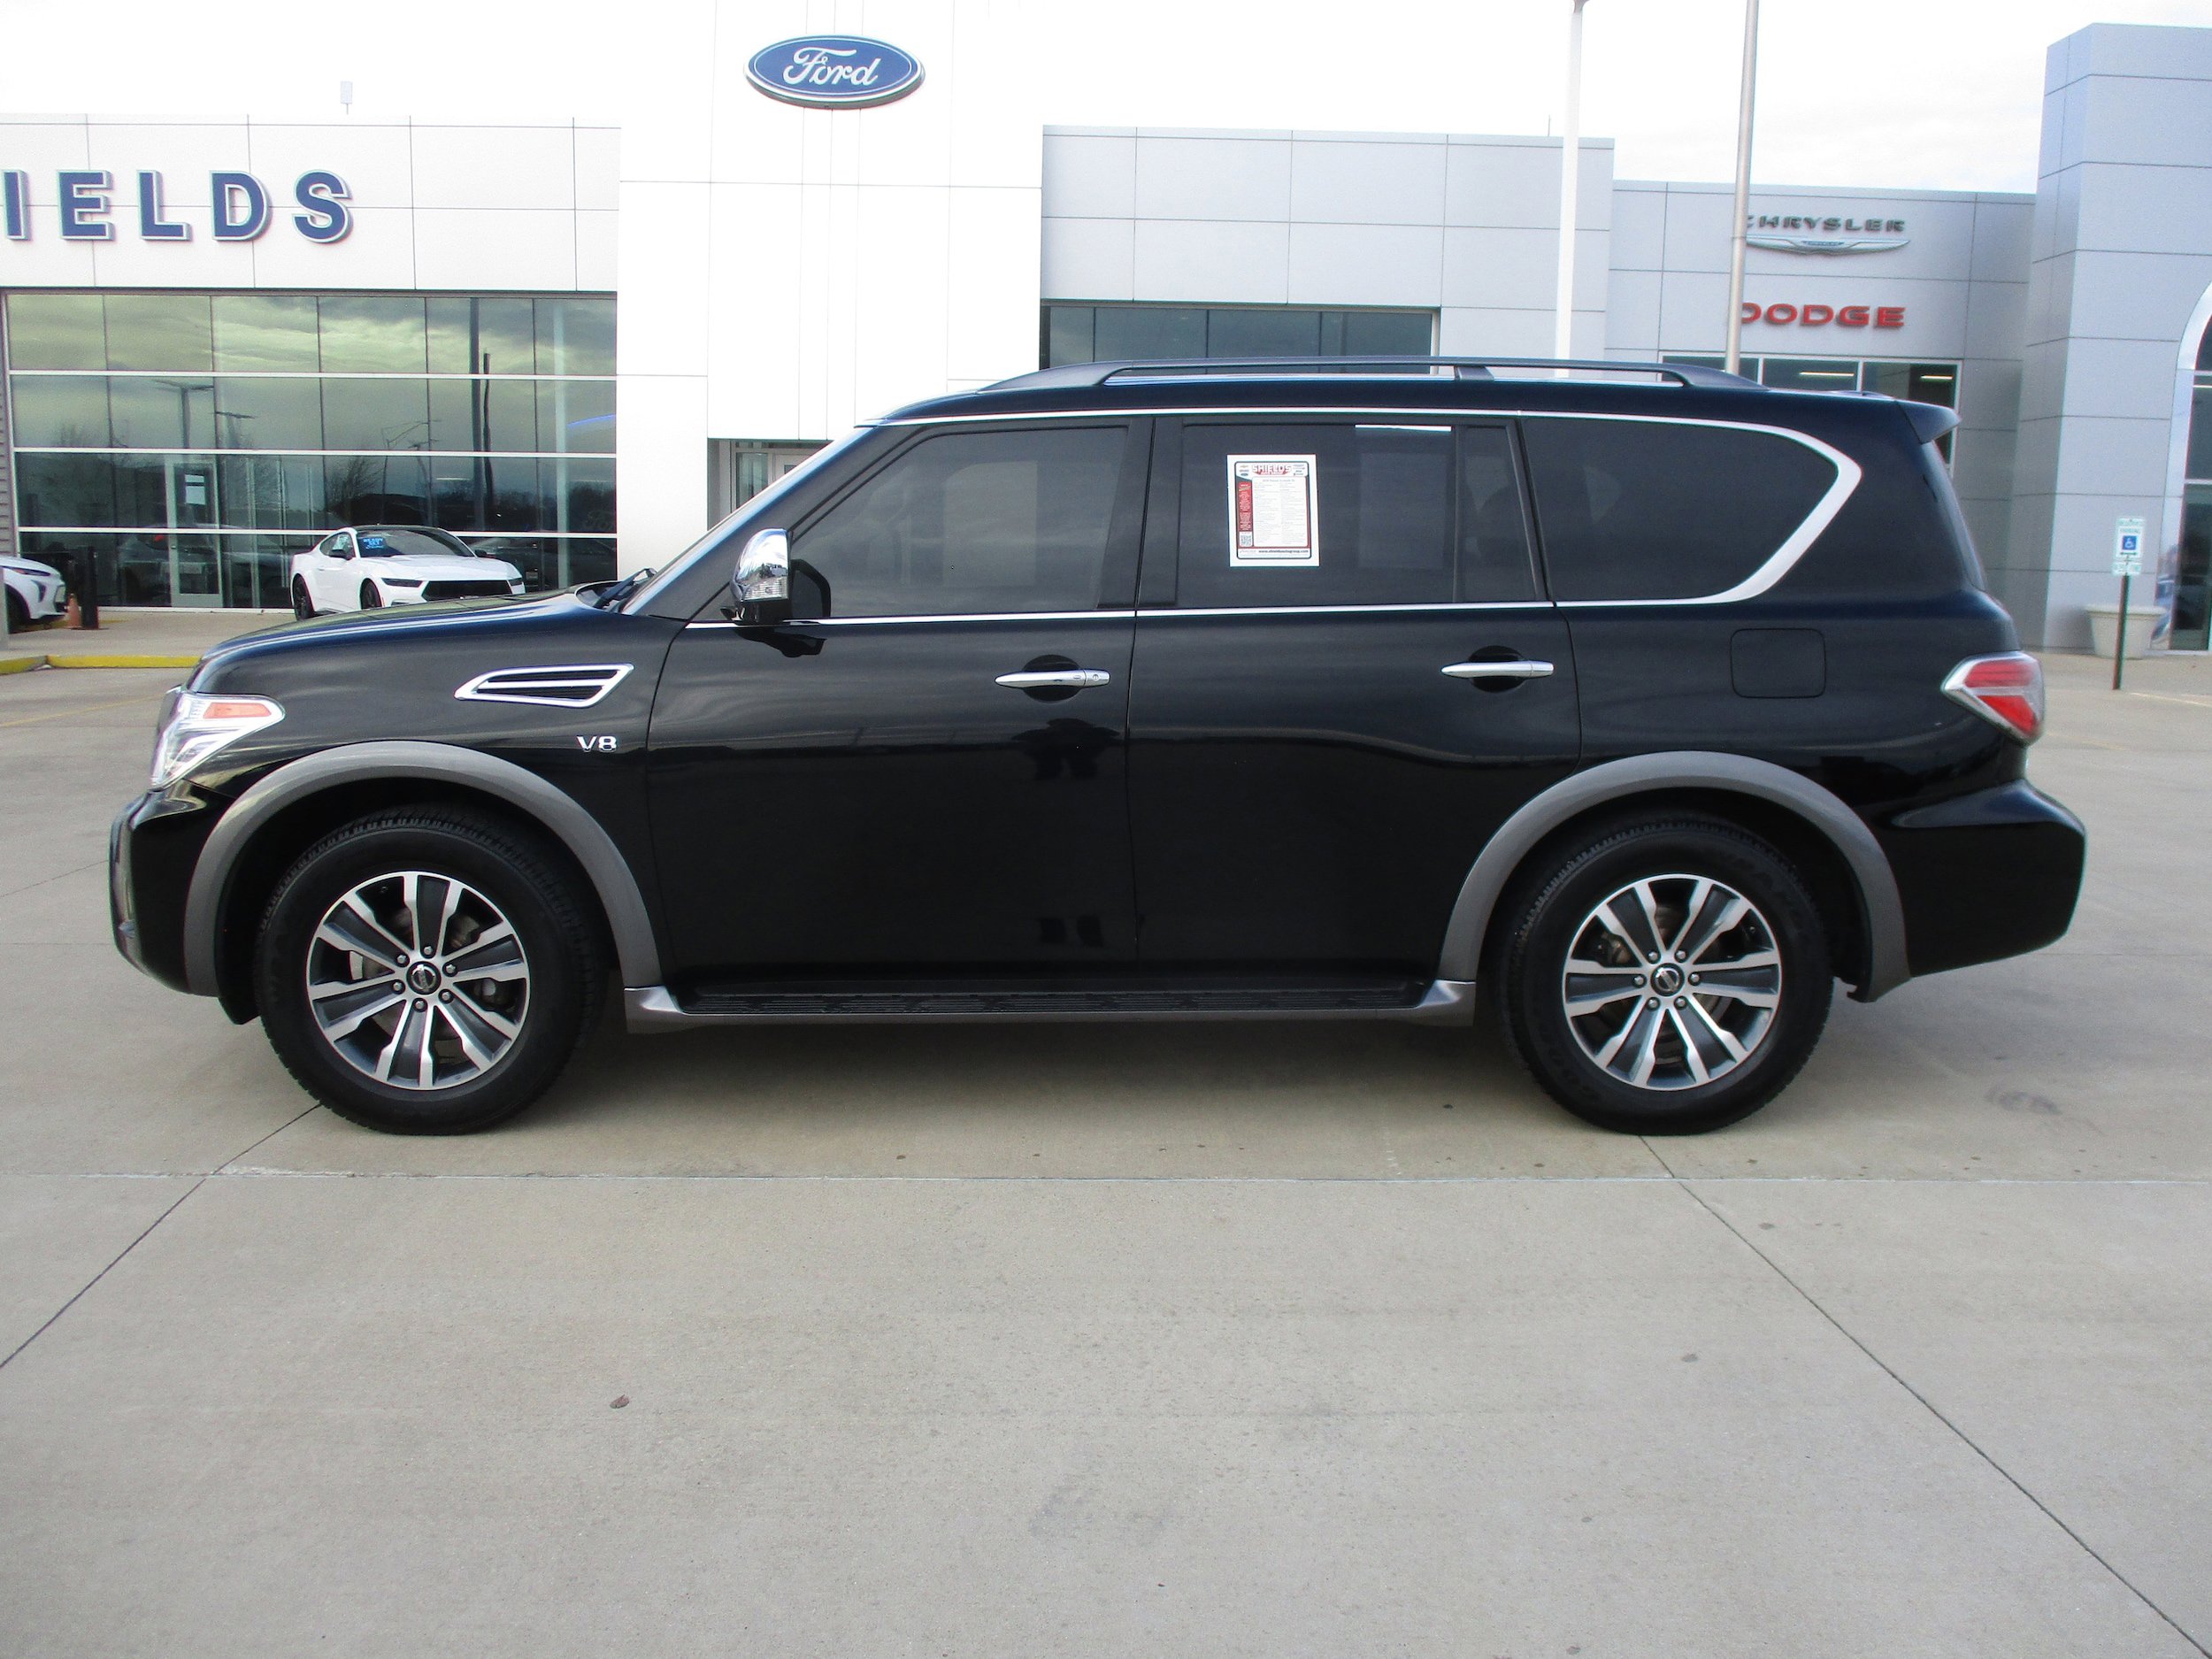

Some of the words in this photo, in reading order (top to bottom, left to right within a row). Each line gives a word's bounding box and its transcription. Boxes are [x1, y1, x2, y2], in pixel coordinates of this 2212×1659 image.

[782, 46, 882, 87] Ford
[2, 169, 353, 244] IELDS
[1740, 302, 1907, 328] DODGE
[1252, 464, 1292, 473] SHIELDS
[576, 735, 617, 752] V8
